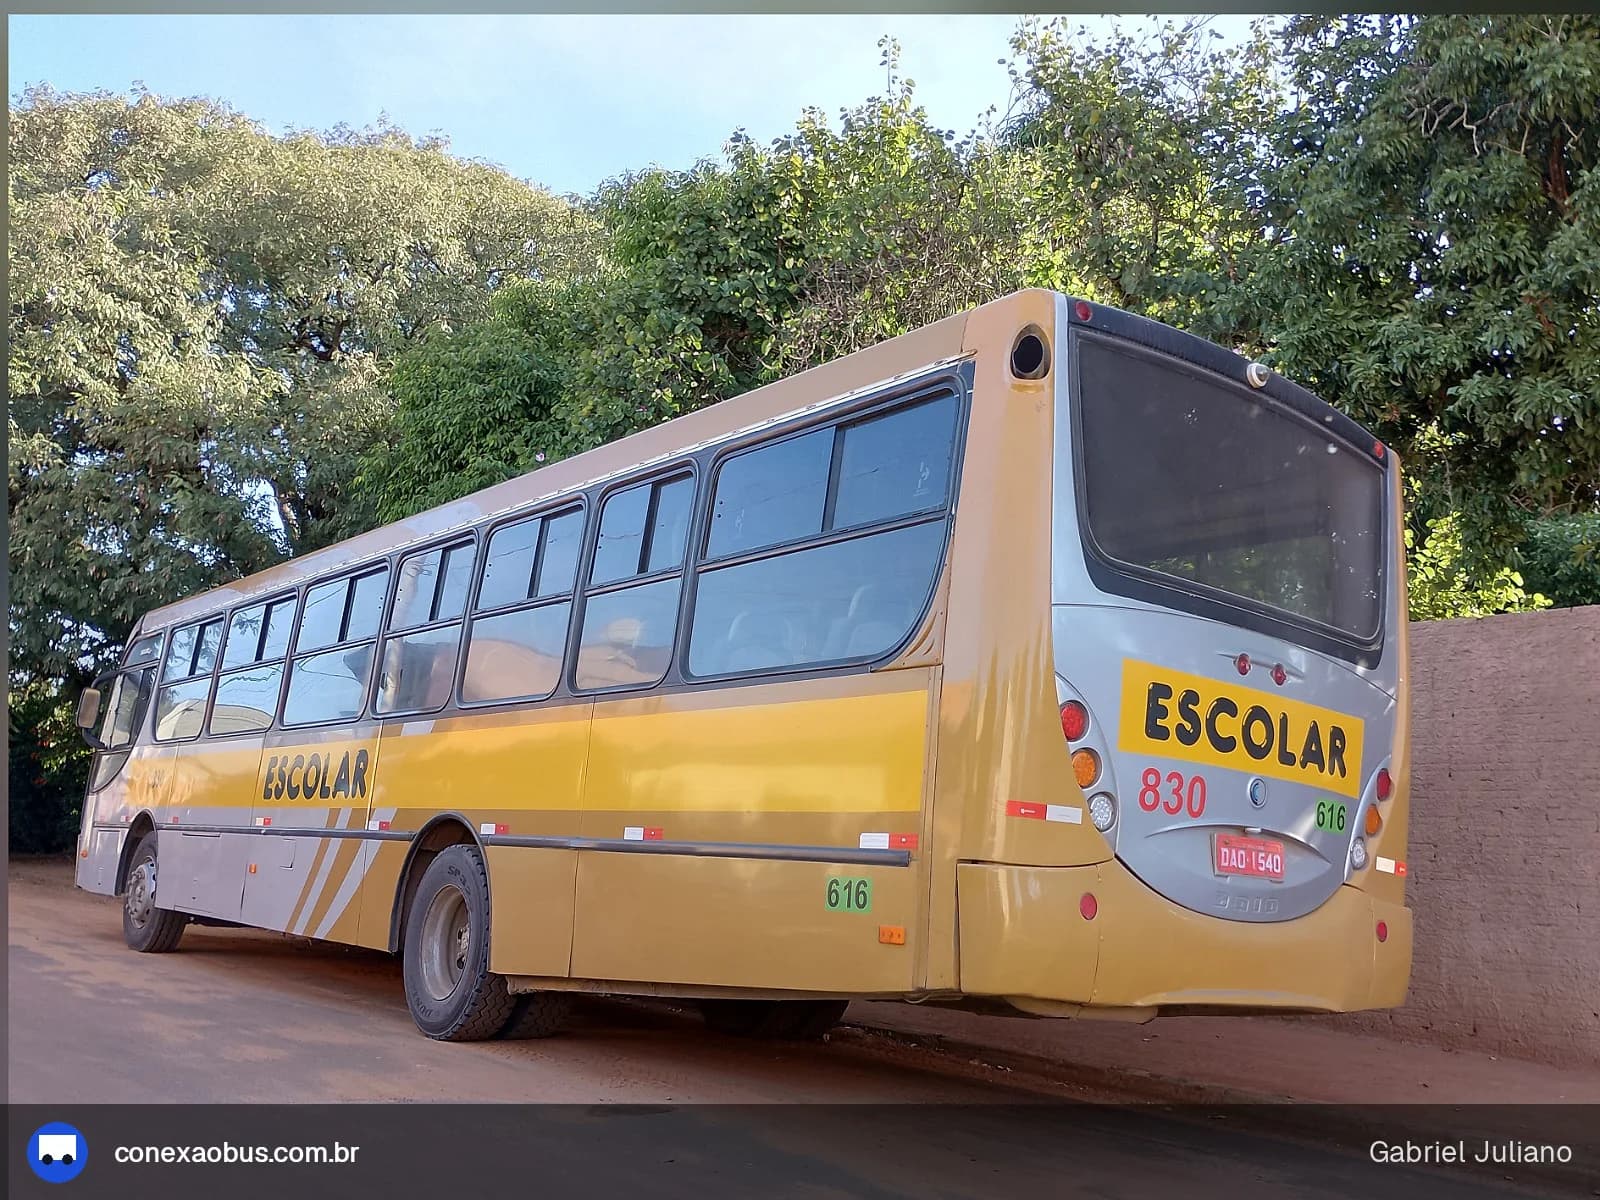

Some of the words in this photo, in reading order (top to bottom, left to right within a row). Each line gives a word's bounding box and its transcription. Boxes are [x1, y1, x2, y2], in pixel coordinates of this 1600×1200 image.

[1144, 681, 1347, 779] ESCOLAR
[262, 748, 370, 801] ESCOLAR
[1138, 767, 1207, 819] 830
[1316, 801, 1346, 831] 616
[827, 878, 868, 910] 616
